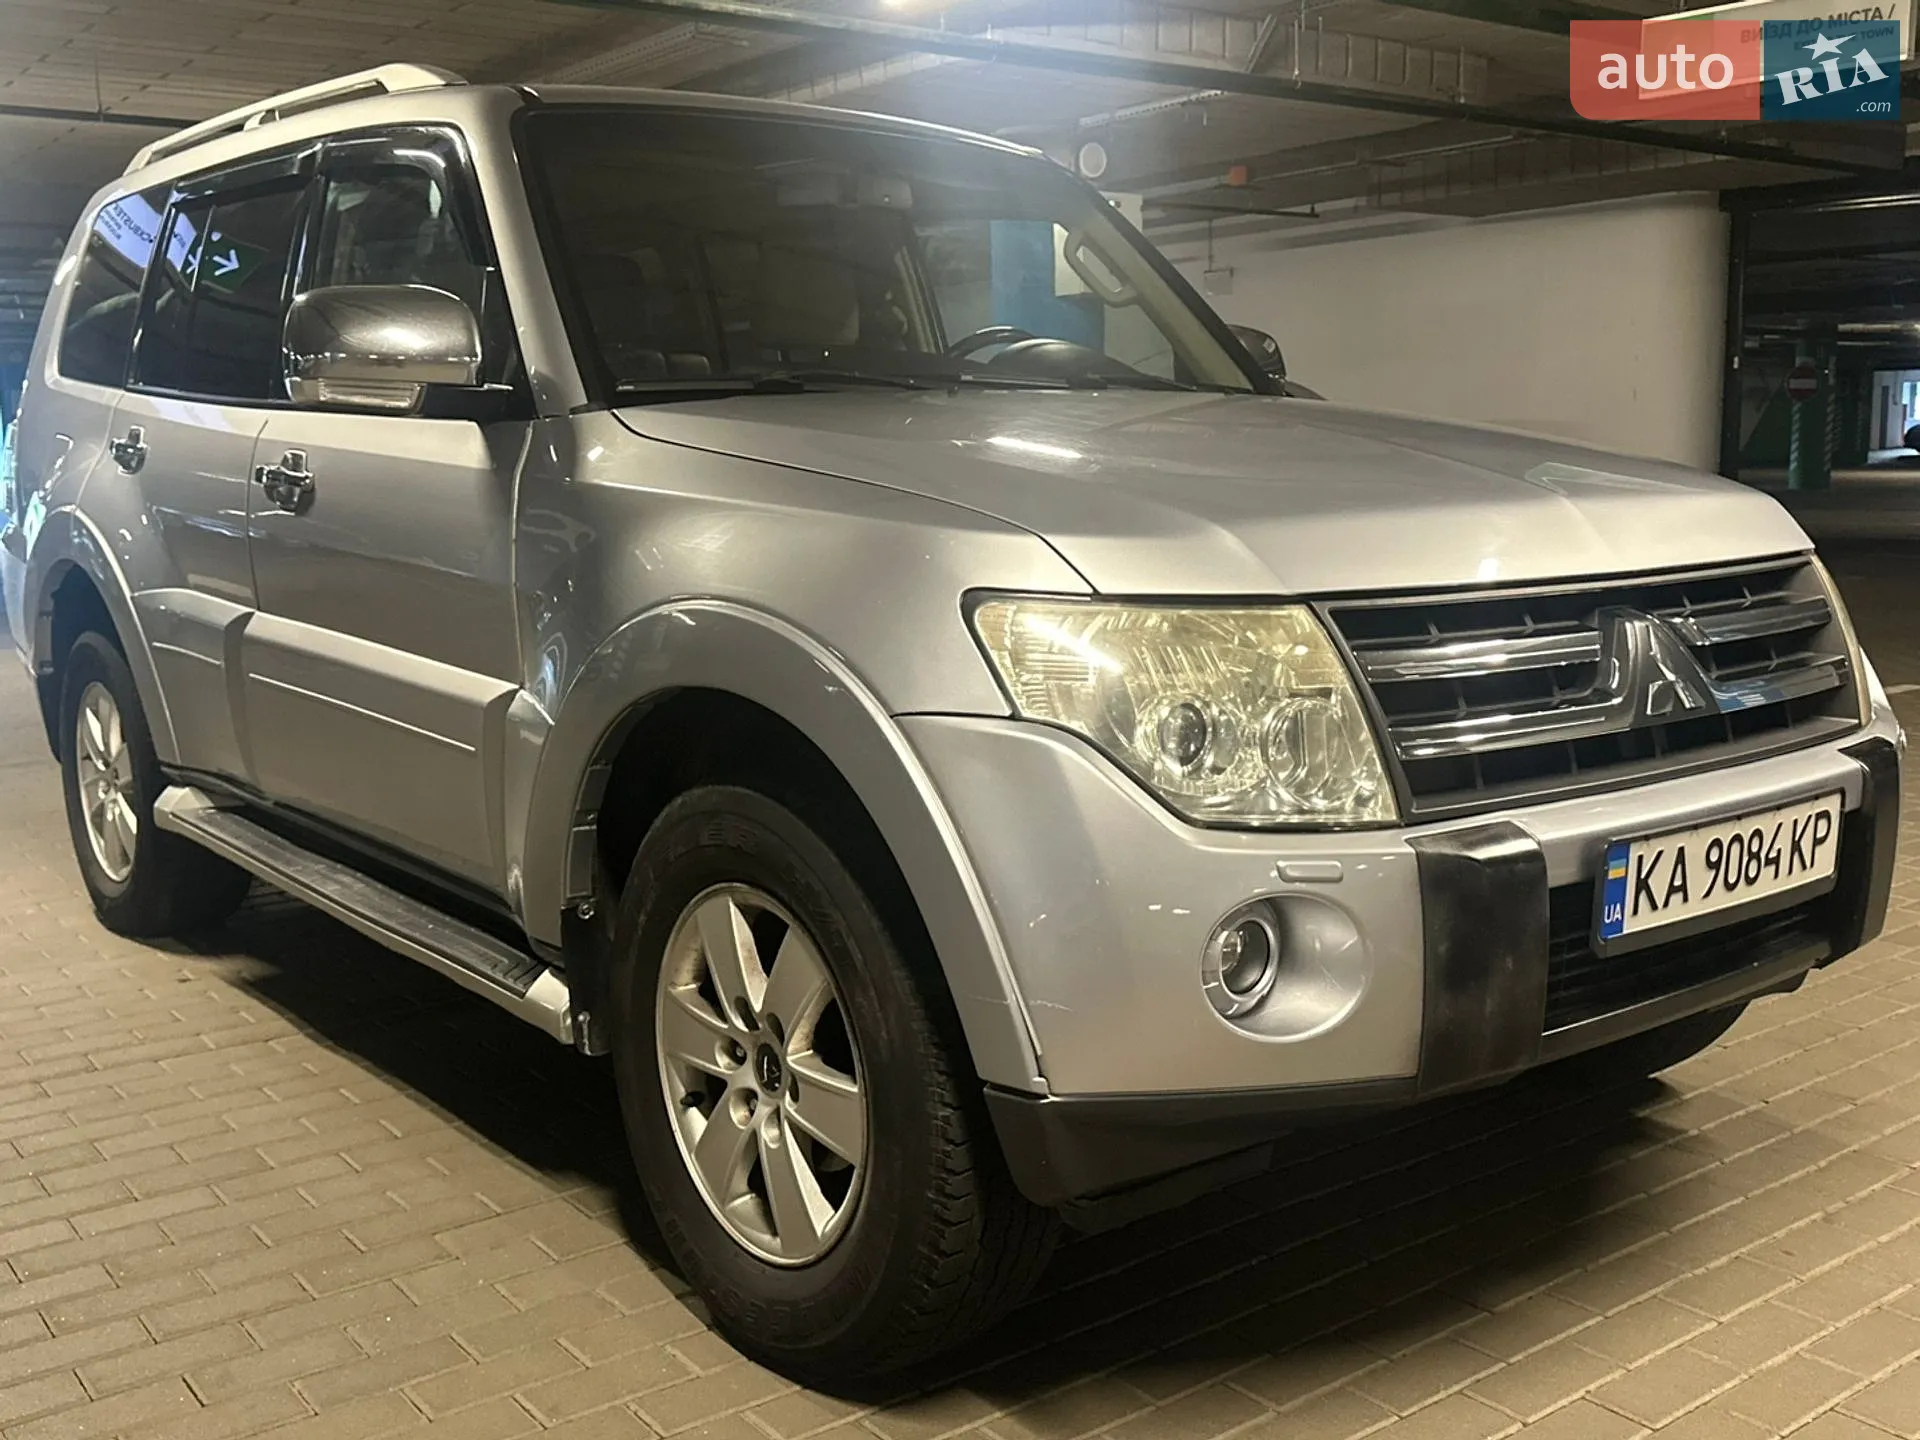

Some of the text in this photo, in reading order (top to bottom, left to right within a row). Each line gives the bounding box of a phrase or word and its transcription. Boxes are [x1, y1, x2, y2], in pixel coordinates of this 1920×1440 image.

[1796, 17, 1824, 36] ДО
[1828, 6, 1884, 29] МІСТА
[1860, 26, 1895, 41] TOWN
[1631, 809, 1832, 916] KA 9084 KP
[1603, 903, 1622, 925] UA
